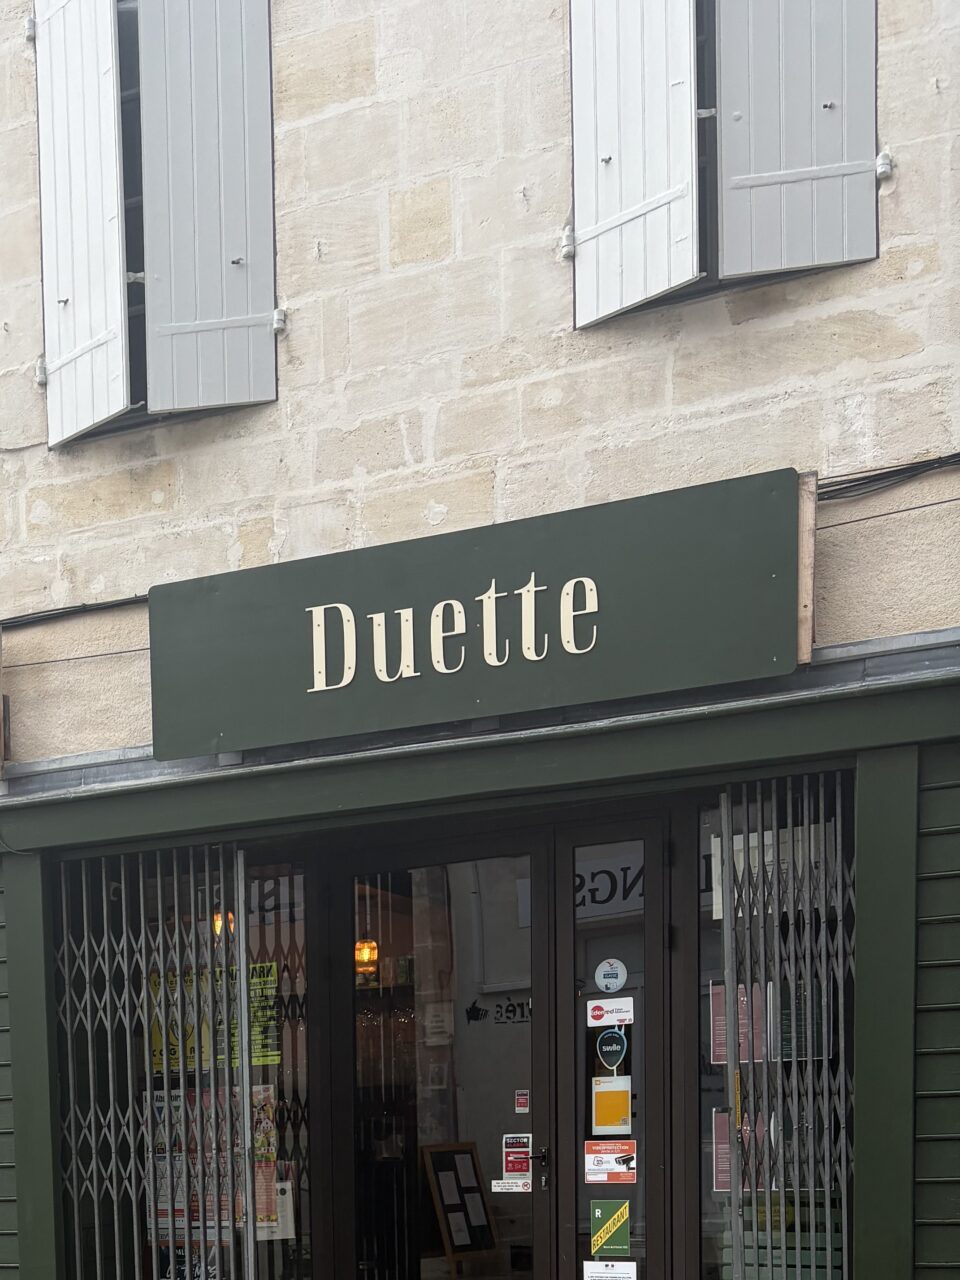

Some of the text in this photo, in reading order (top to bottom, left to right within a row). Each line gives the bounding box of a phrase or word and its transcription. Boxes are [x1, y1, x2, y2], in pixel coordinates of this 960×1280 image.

[305, 572, 599, 693] Duette
[602, 1043, 621, 1052] swile
[595, 1208, 602, 1218] R
[592, 1205, 629, 1251] RESTAURANT
